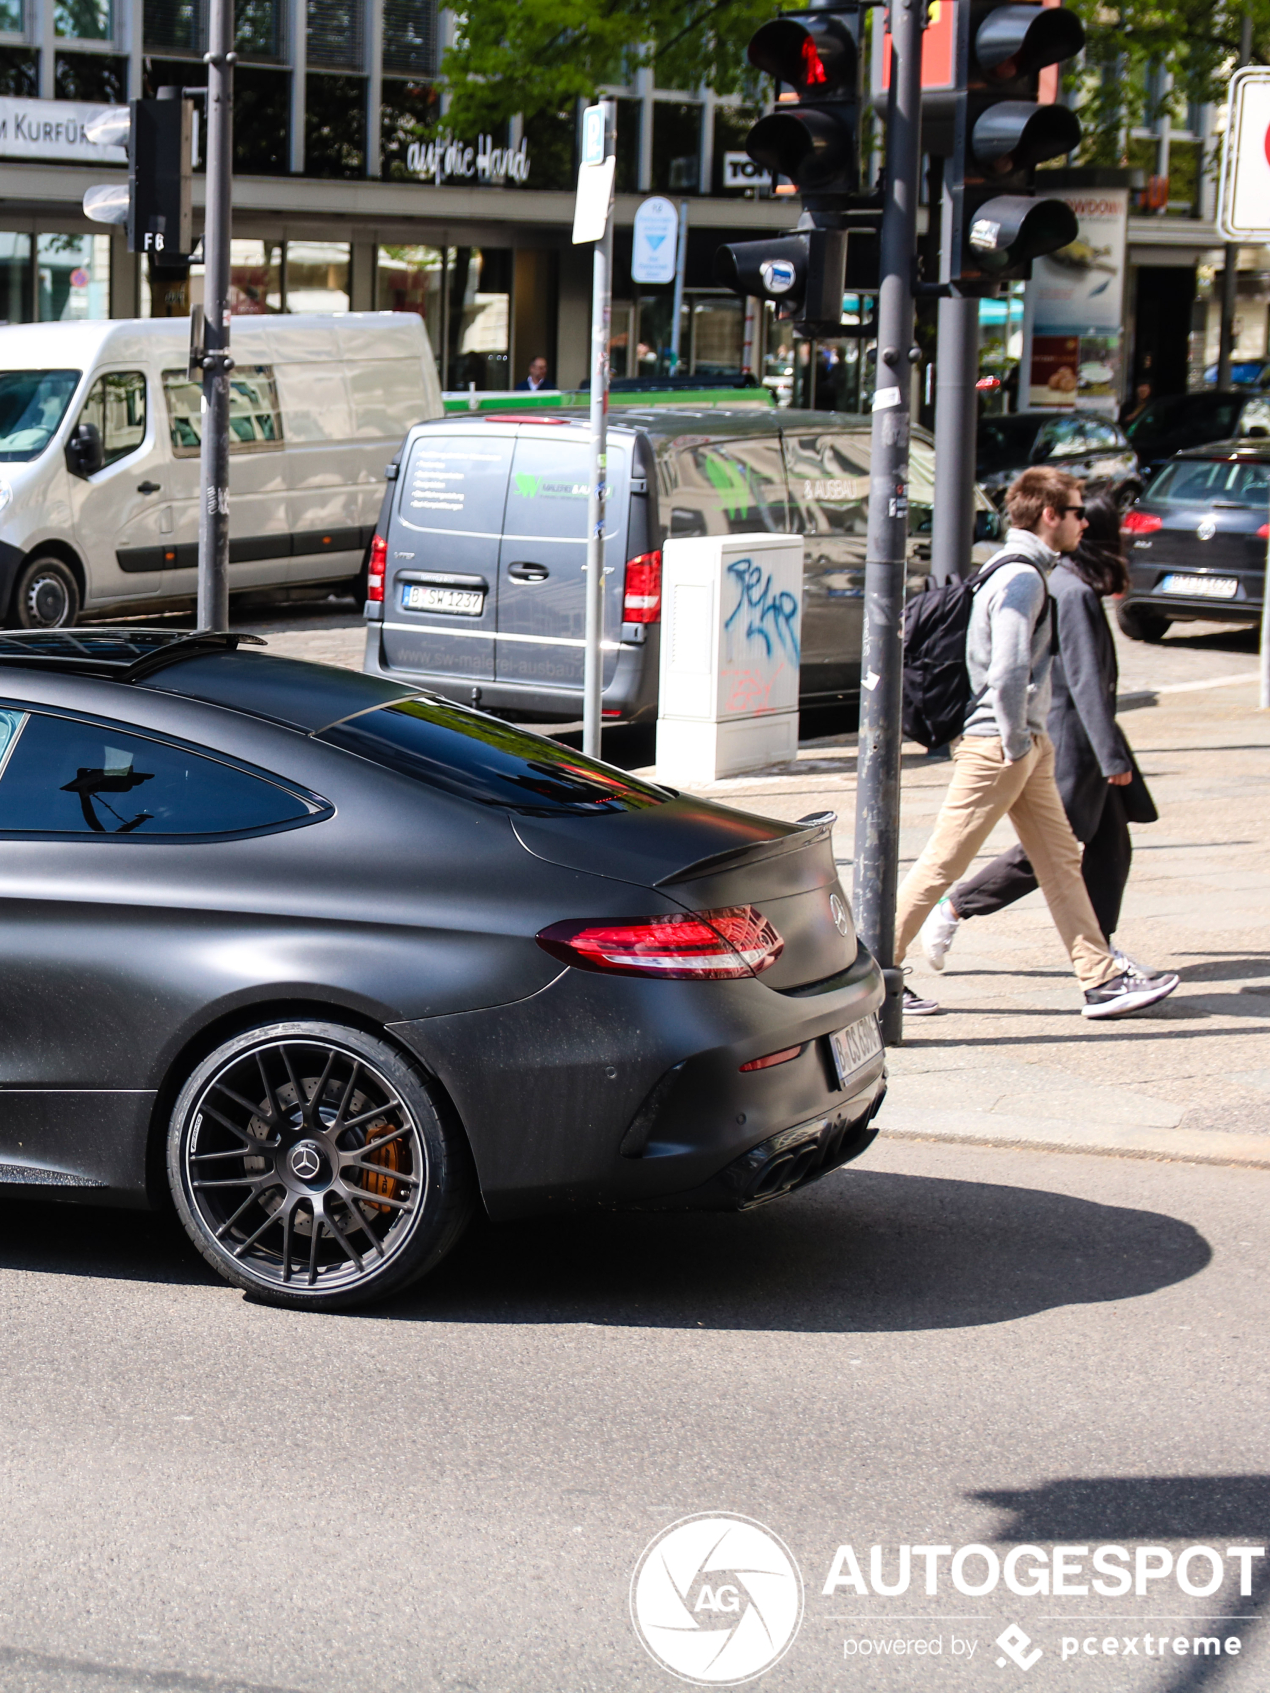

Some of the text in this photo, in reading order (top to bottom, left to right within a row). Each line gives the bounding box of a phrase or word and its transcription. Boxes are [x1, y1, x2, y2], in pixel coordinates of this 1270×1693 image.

[407, 132, 531, 187] auf die Hand
[814, 479, 857, 500] AUSBAU
[411, 588, 420, 603] B
[447, 591, 481, 609] 1237
